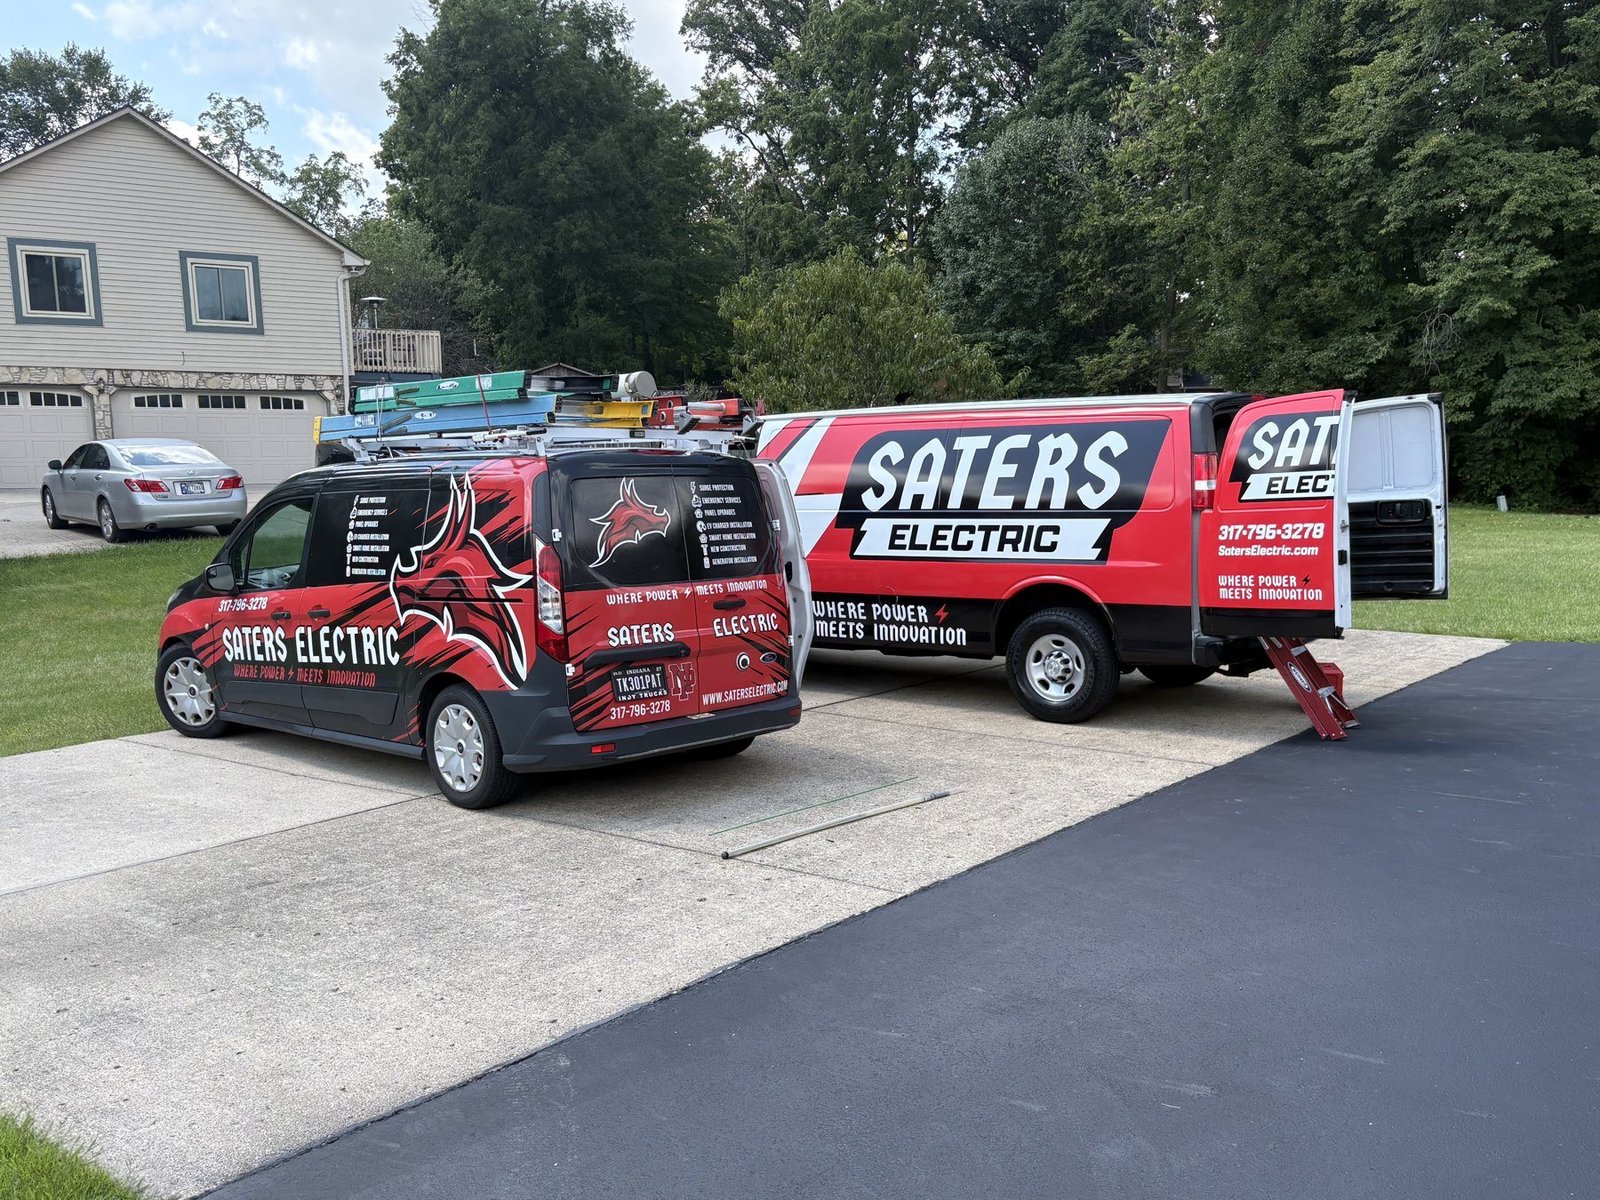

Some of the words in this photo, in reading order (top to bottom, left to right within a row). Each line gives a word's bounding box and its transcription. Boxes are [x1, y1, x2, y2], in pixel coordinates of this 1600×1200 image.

[1247, 415, 1340, 470] SAT
[861, 430, 1128, 512] SATERS
[1265, 474, 1335, 495] ELEC
[888, 524, 1060, 553] ELECTRIC
[1218, 545, 1319, 556] SatersElectric.com
[606, 591, 643, 605] WHERE
[645, 589, 679, 602] POWER
[696, 583, 724, 596] MEETS
[726, 579, 768, 593] INNOVATION
[1218, 575, 1255, 587] WHERE
[1258, 575, 1297, 587] POWER
[218, 596, 268, 612] 317-796-3278
[1219, 588, 1253, 600] MEETS
[1258, 588, 1323, 600] INNOVATION
[812, 600, 867, 620] WHERE
[871, 603, 929, 623] POWER
[607, 622, 675, 647] SATERS
[713, 612, 779, 638] ELECTRIC
[816, 620, 865, 640] MEETS
[873, 623, 967, 646] INNOVATION
[222, 625, 288, 663] SATERS
[295, 625, 400, 666] ELECTRIC
[233, 663, 258, 679] WHERE
[259, 665, 286, 681] POWER
[297, 668, 323, 684] MEETS
[326, 668, 376, 688] INNOVATION
[616, 673, 661, 693] TK301PAT
[702, 680, 788, 706] WWW.SATERSELECTRIC.COM
[610, 699, 671, 720] 317-796-3278
